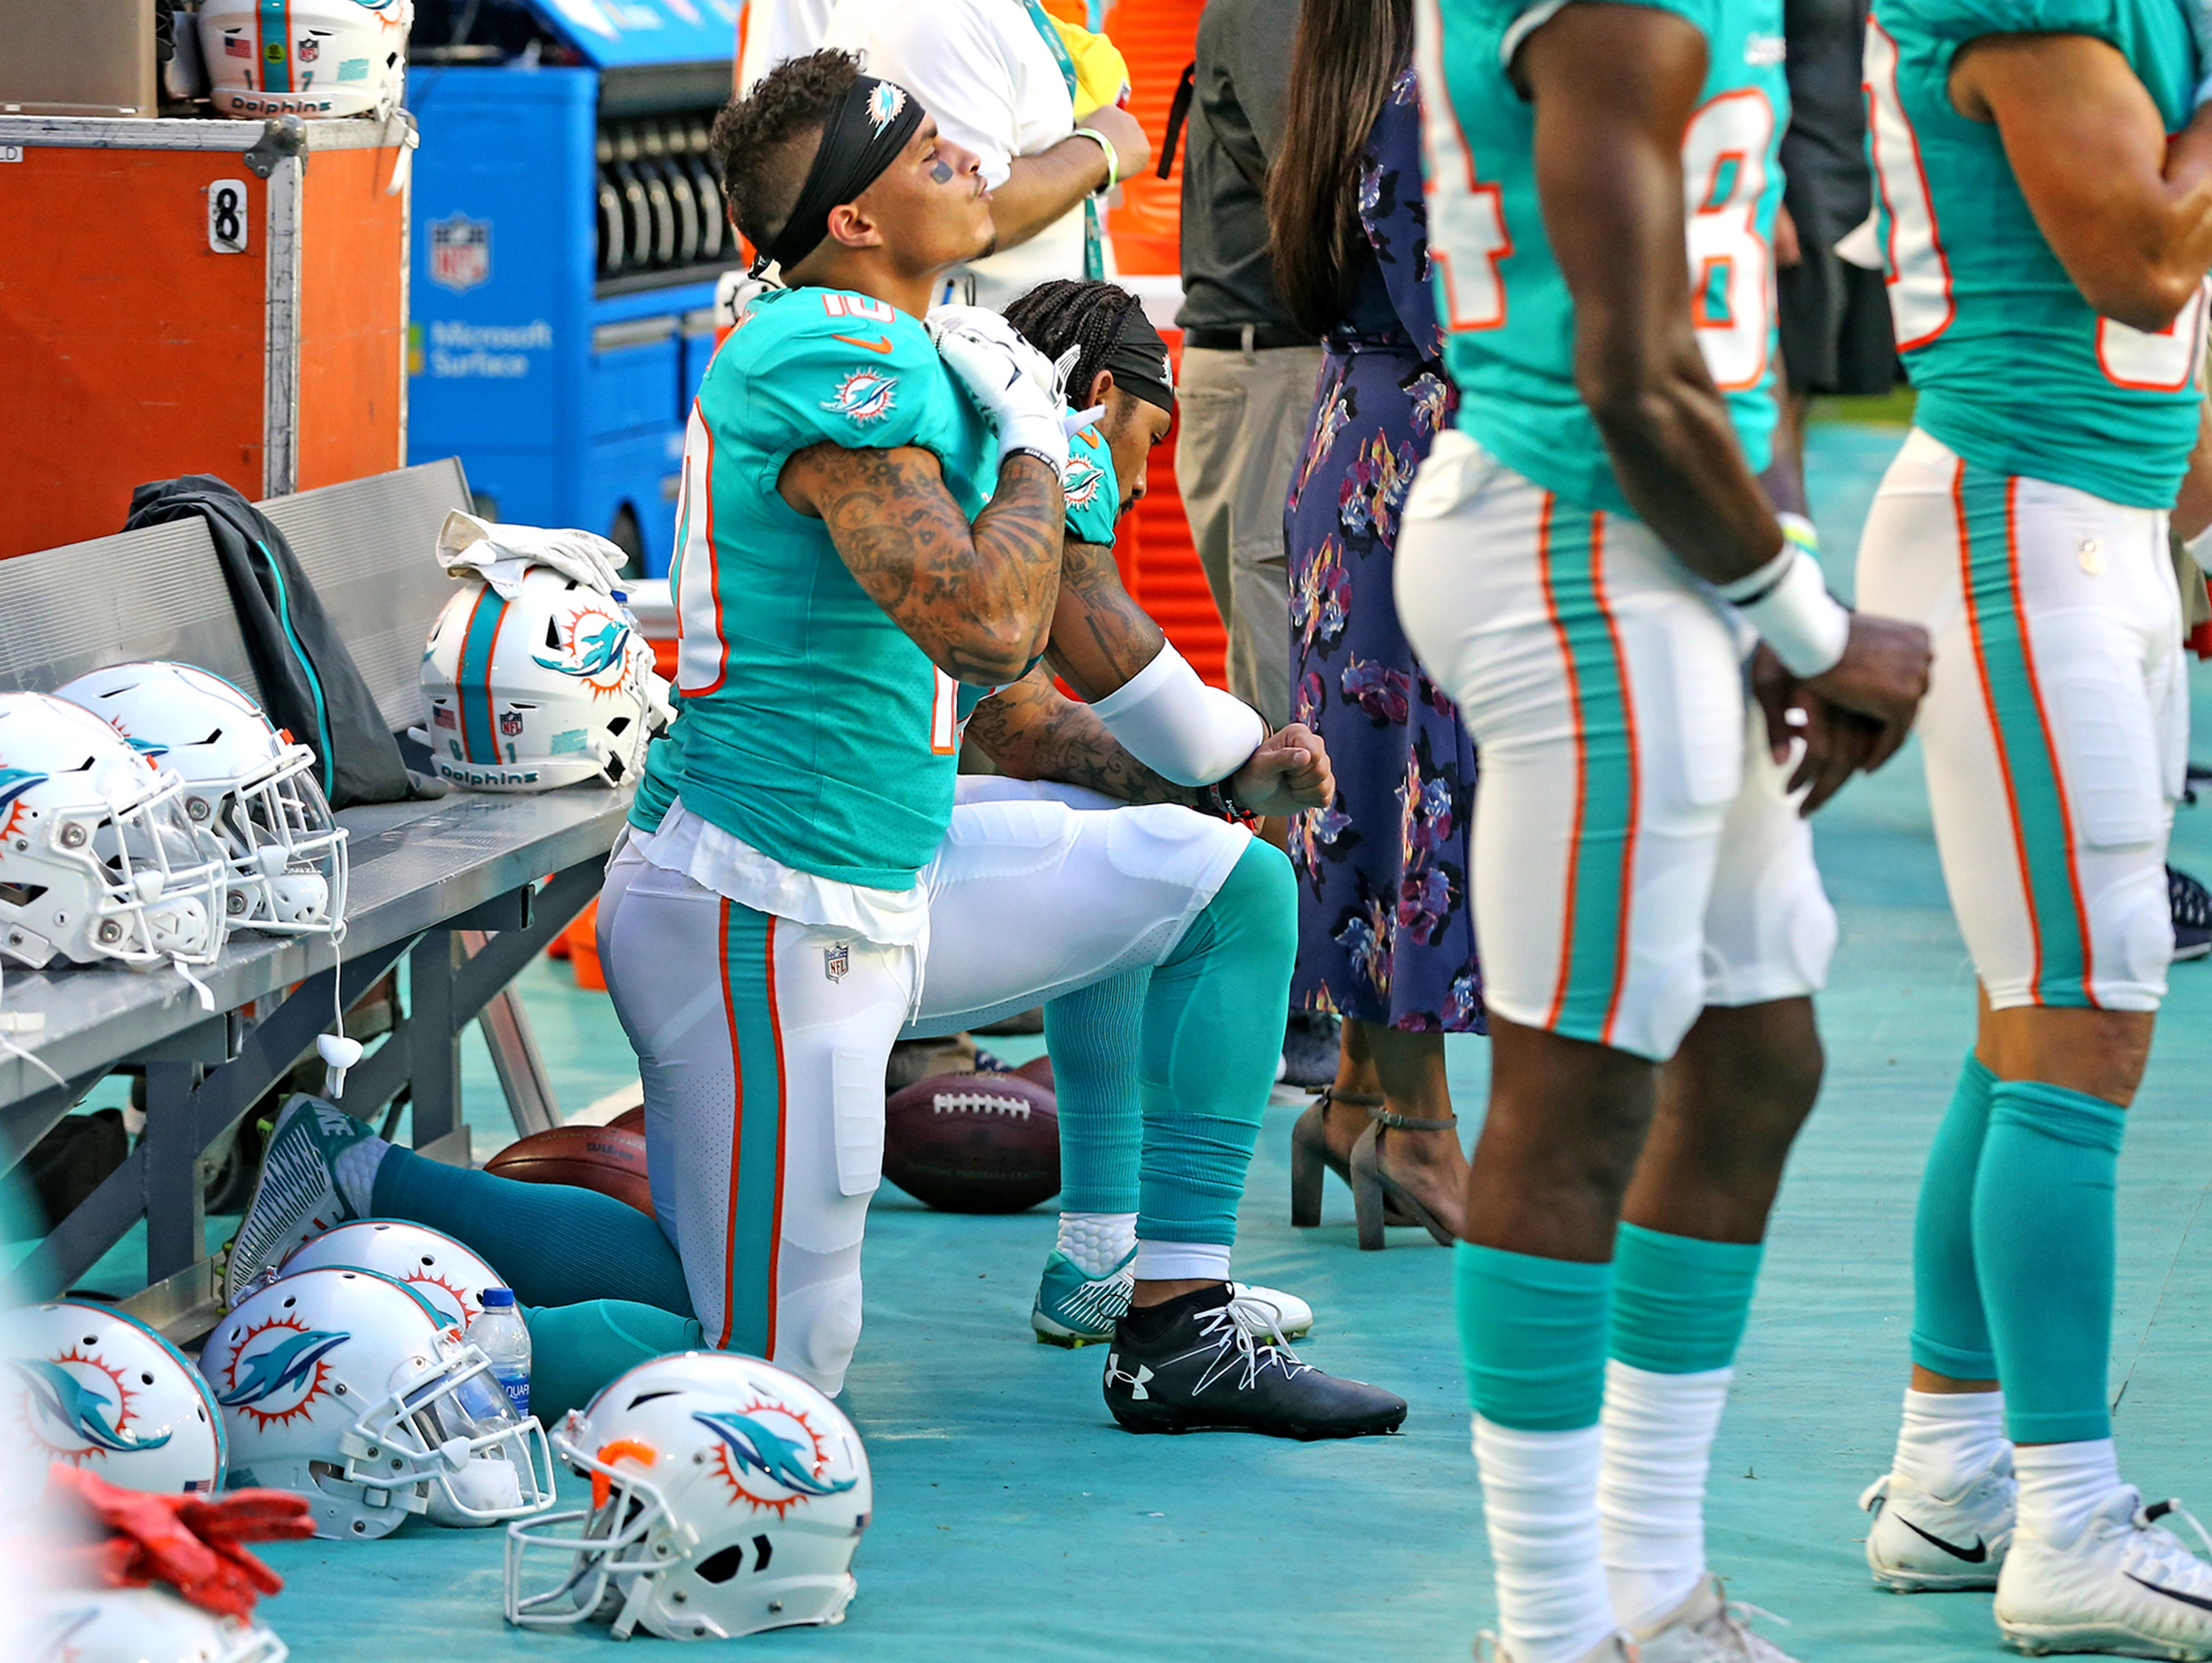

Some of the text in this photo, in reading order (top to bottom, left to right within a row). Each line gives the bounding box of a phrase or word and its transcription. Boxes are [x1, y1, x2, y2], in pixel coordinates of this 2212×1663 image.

[231, 95, 333, 115] Dolphins
[215, 187, 240, 242] 8
[431, 320, 553, 349] Microsoft
[431, 349, 529, 378] Surface
[502, 719, 521, 735] NFL
[449, 739, 517, 764] 8 1
[441, 764, 539, 787] Dolphins
[830, 959, 846, 976] NFL
